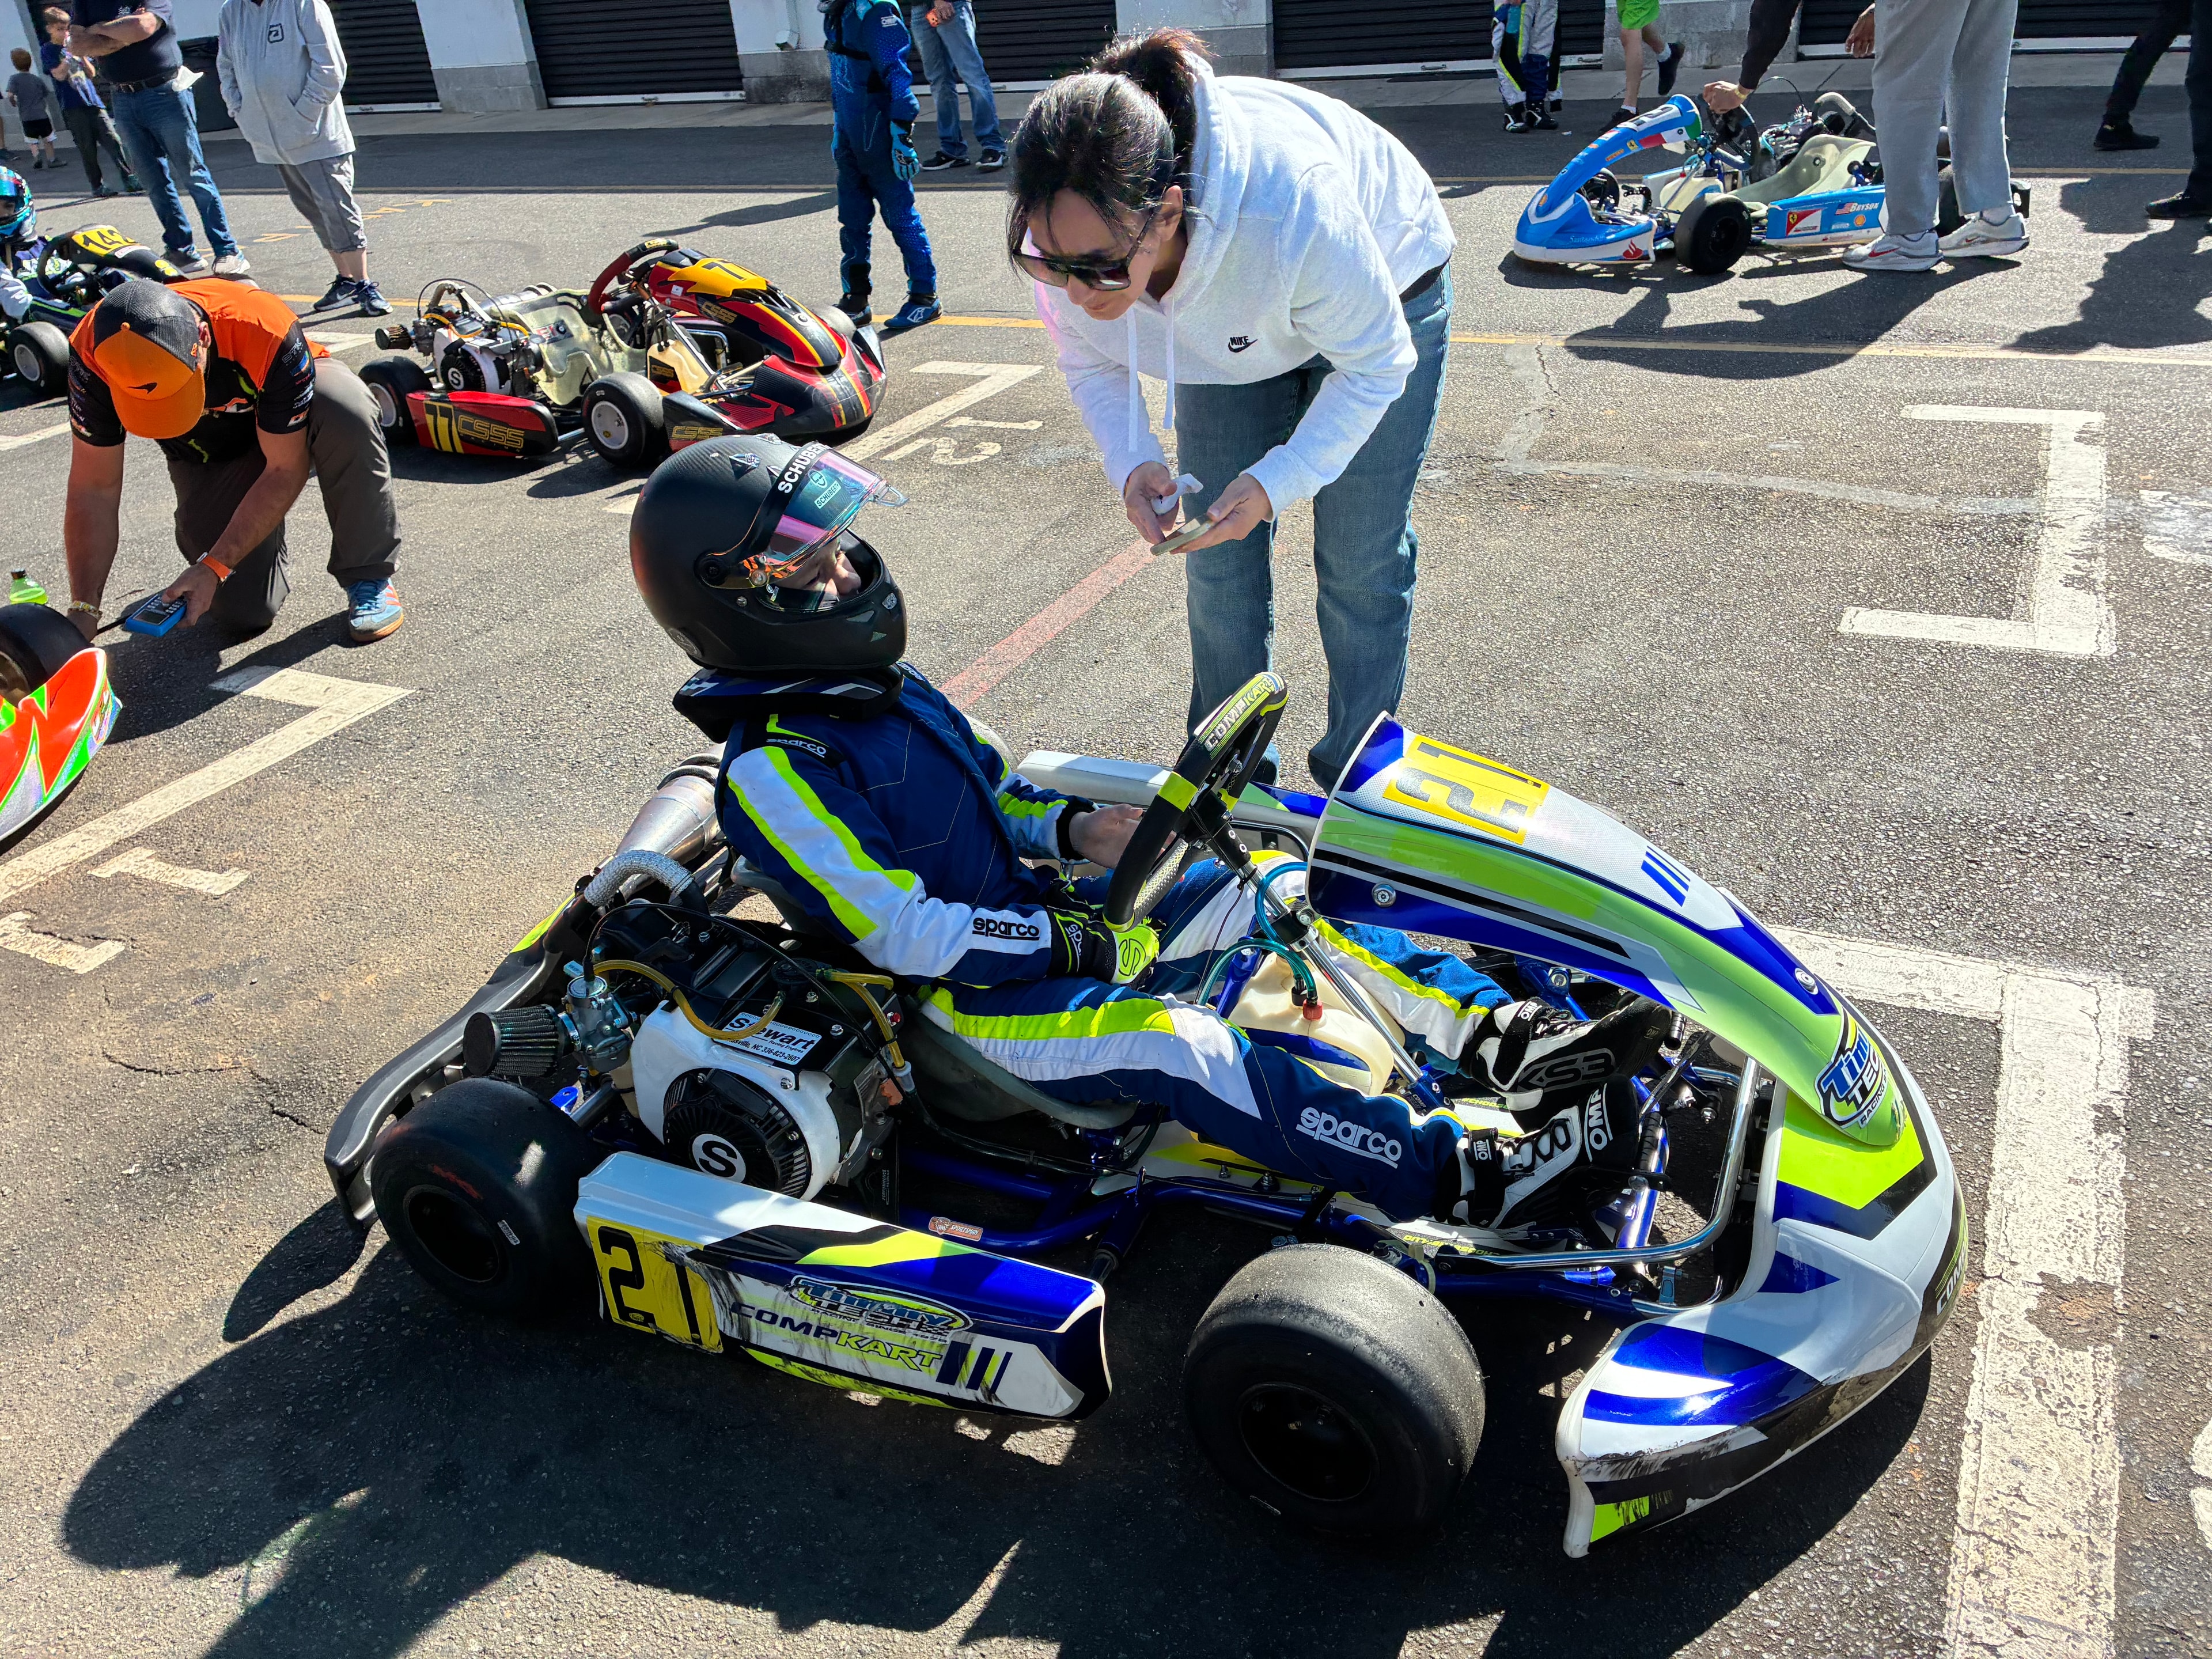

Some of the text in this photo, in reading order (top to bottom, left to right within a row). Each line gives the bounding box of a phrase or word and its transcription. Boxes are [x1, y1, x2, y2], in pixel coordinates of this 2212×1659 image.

[1229, 335, 1249, 346] NIKE
[451, 370, 461, 387] S
[425, 402, 459, 454] 77
[766, 738, 827, 756] sparco
[1395, 741, 1542, 834] 21
[972, 916, 1040, 938] sparco
[1521, 1001, 1539, 1020] OMP
[761, 1047, 801, 1062] 336-823-2607
[768, 1039, 804, 1054] Racing Engines
[1859, 1083, 1885, 1125] RACING
[1588, 1089, 1608, 1150] OMP
[1300, 1107, 1402, 1162] sparco
[699, 1140, 737, 1178] S
[1476, 1139, 1489, 1160] OMP
[950, 1224, 979, 1236] SPORTSMAN
[597, 1225, 704, 1346] 21
[810, 1308, 858, 1324] RACING
[866, 1322, 908, 1336] SINCE
[815, 1298, 922, 1332] TECH
[731, 1301, 943, 1372] COMPKART
